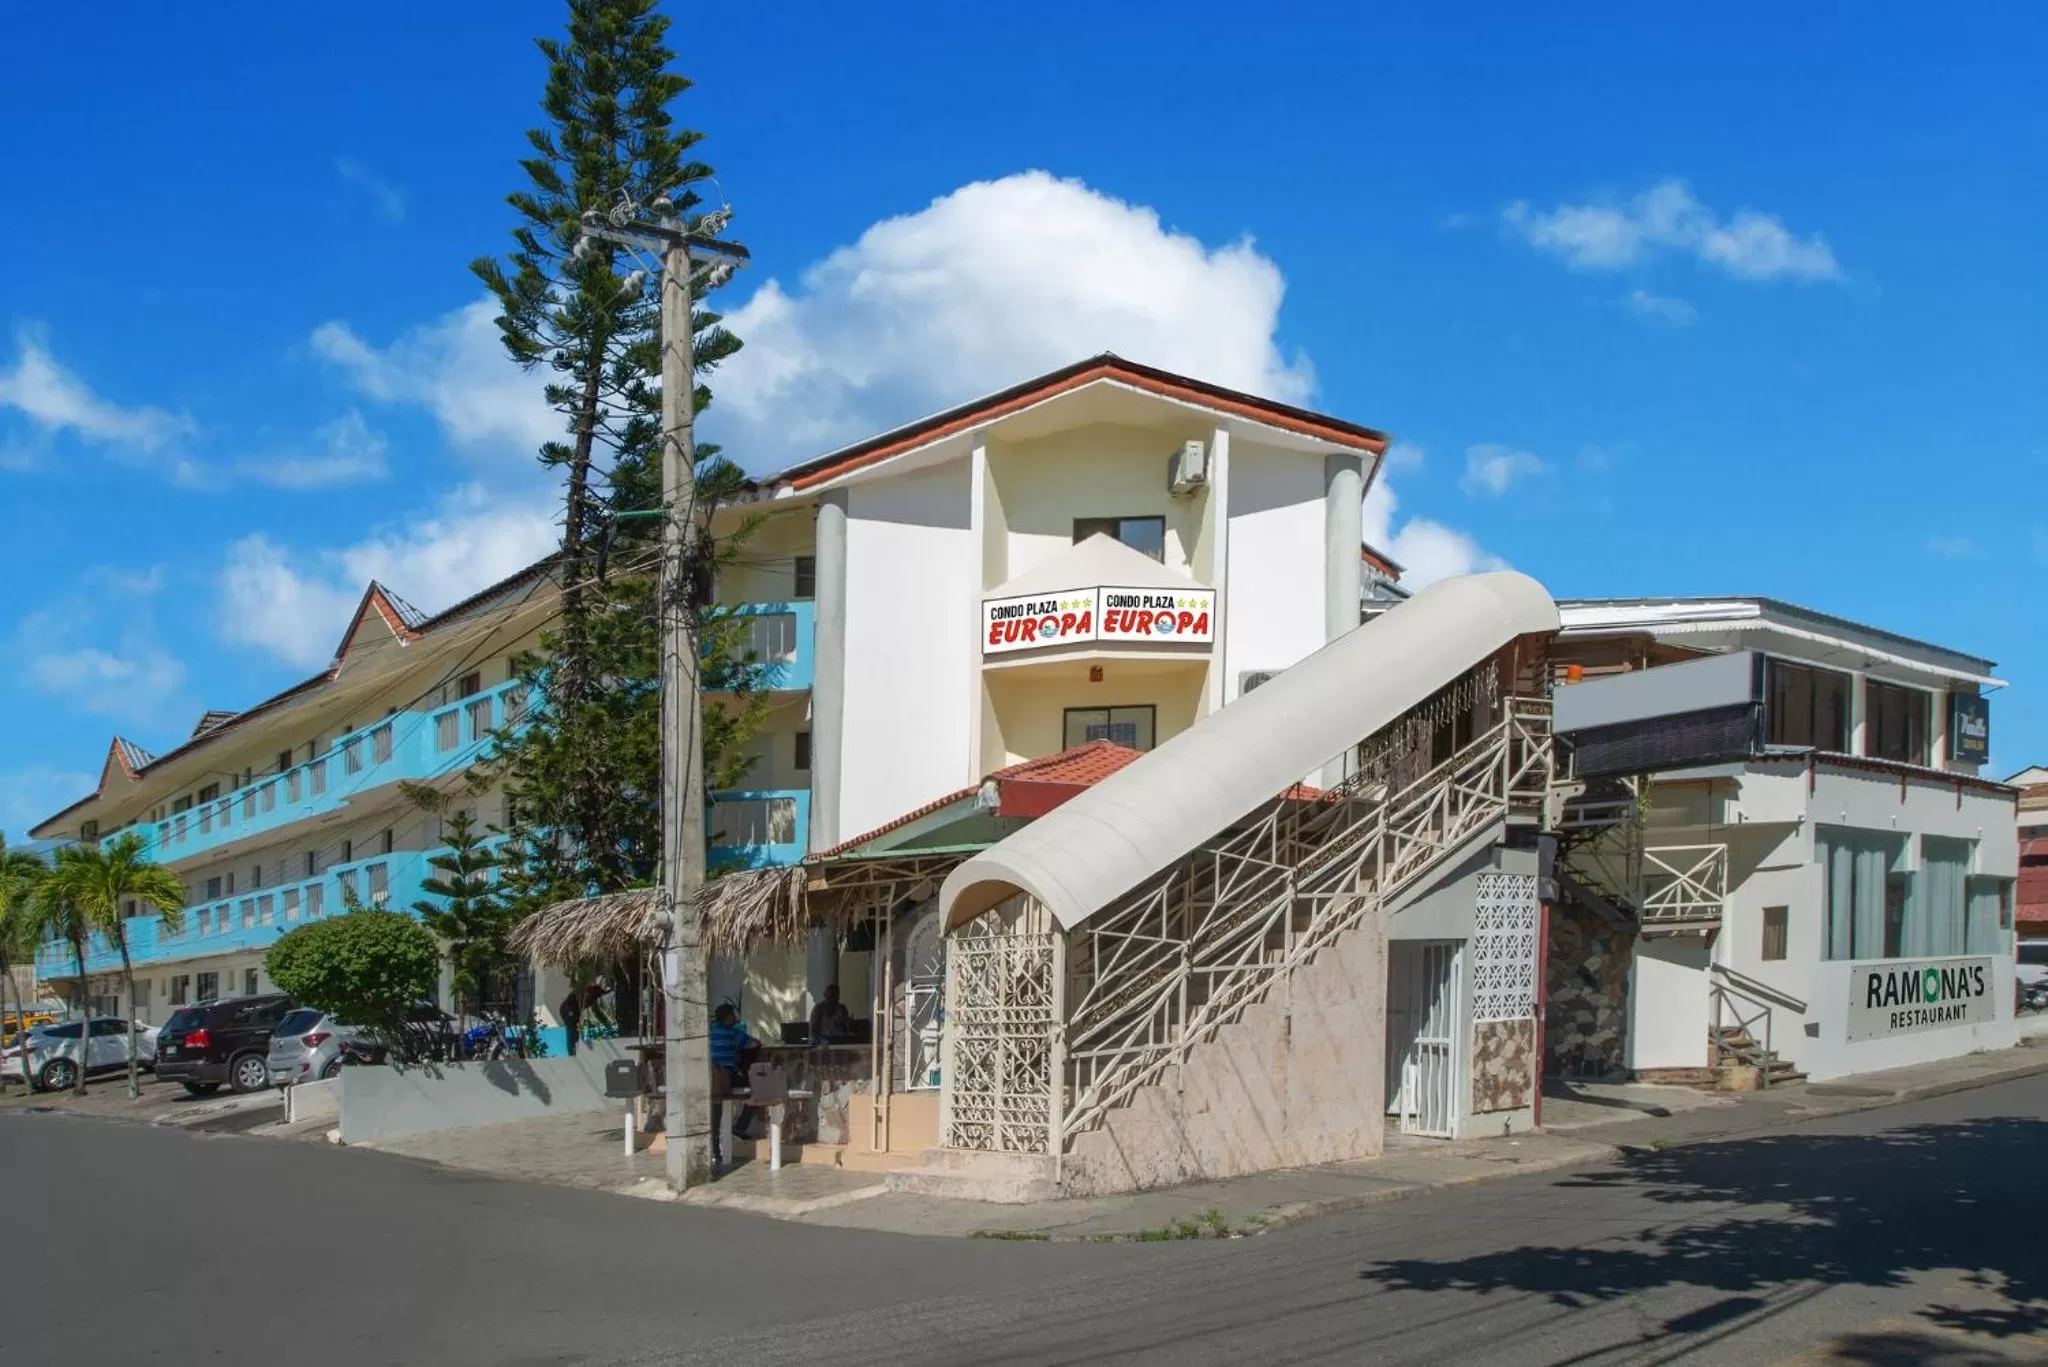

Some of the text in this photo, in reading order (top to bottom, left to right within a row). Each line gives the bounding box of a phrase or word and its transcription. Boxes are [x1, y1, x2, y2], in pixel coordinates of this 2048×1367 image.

[990, 601, 1058, 620] CONDO PLAZA
[1106, 595, 1174, 608] CONDO PLAZA
[989, 611, 1092, 645] EUROPA
[1104, 610, 1209, 636] EUROPA
[1867, 966, 1985, 1009] RAMONA'S
[1890, 1004, 1967, 1029] RESTAURANT
